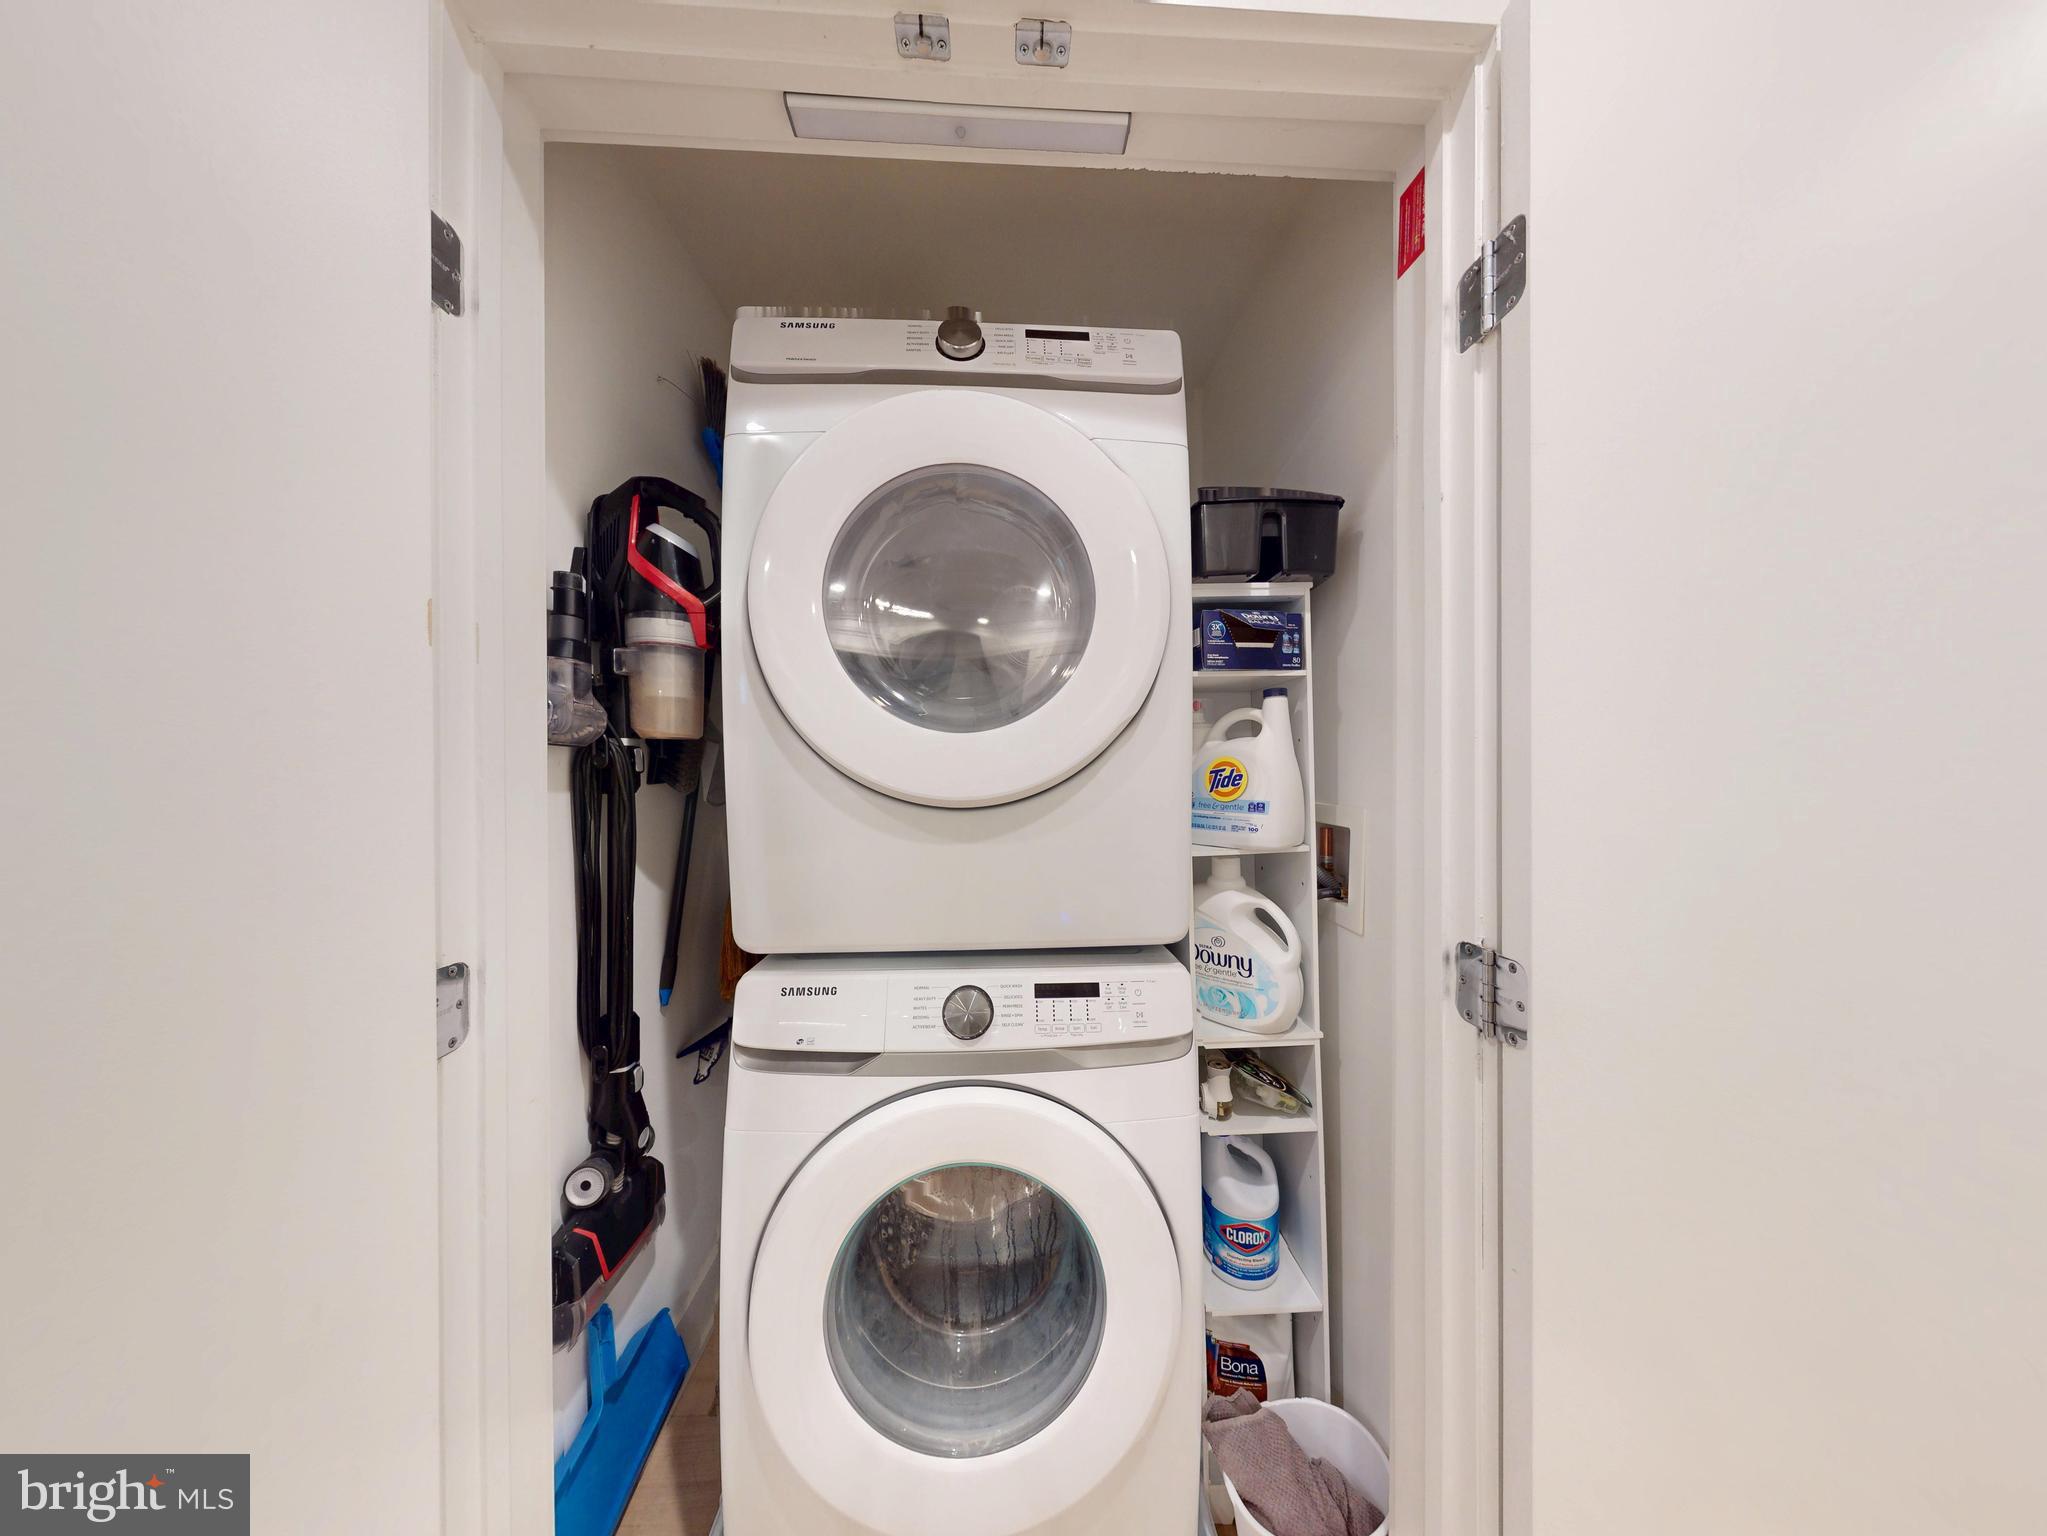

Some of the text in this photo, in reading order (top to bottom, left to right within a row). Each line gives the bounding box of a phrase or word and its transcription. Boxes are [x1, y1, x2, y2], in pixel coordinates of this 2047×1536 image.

[780, 321, 836, 329] SAMSUNG
[1208, 768, 1243, 793] Tide
[1198, 801, 1211, 809] free
[1220, 802, 1244, 810] gentle
[1213, 968, 1237, 977] gentle
[780, 986, 838, 997] SAMSUNG
[1226, 1227, 1266, 1245] CLOROX
[1220, 1356, 1259, 1375] Bona
